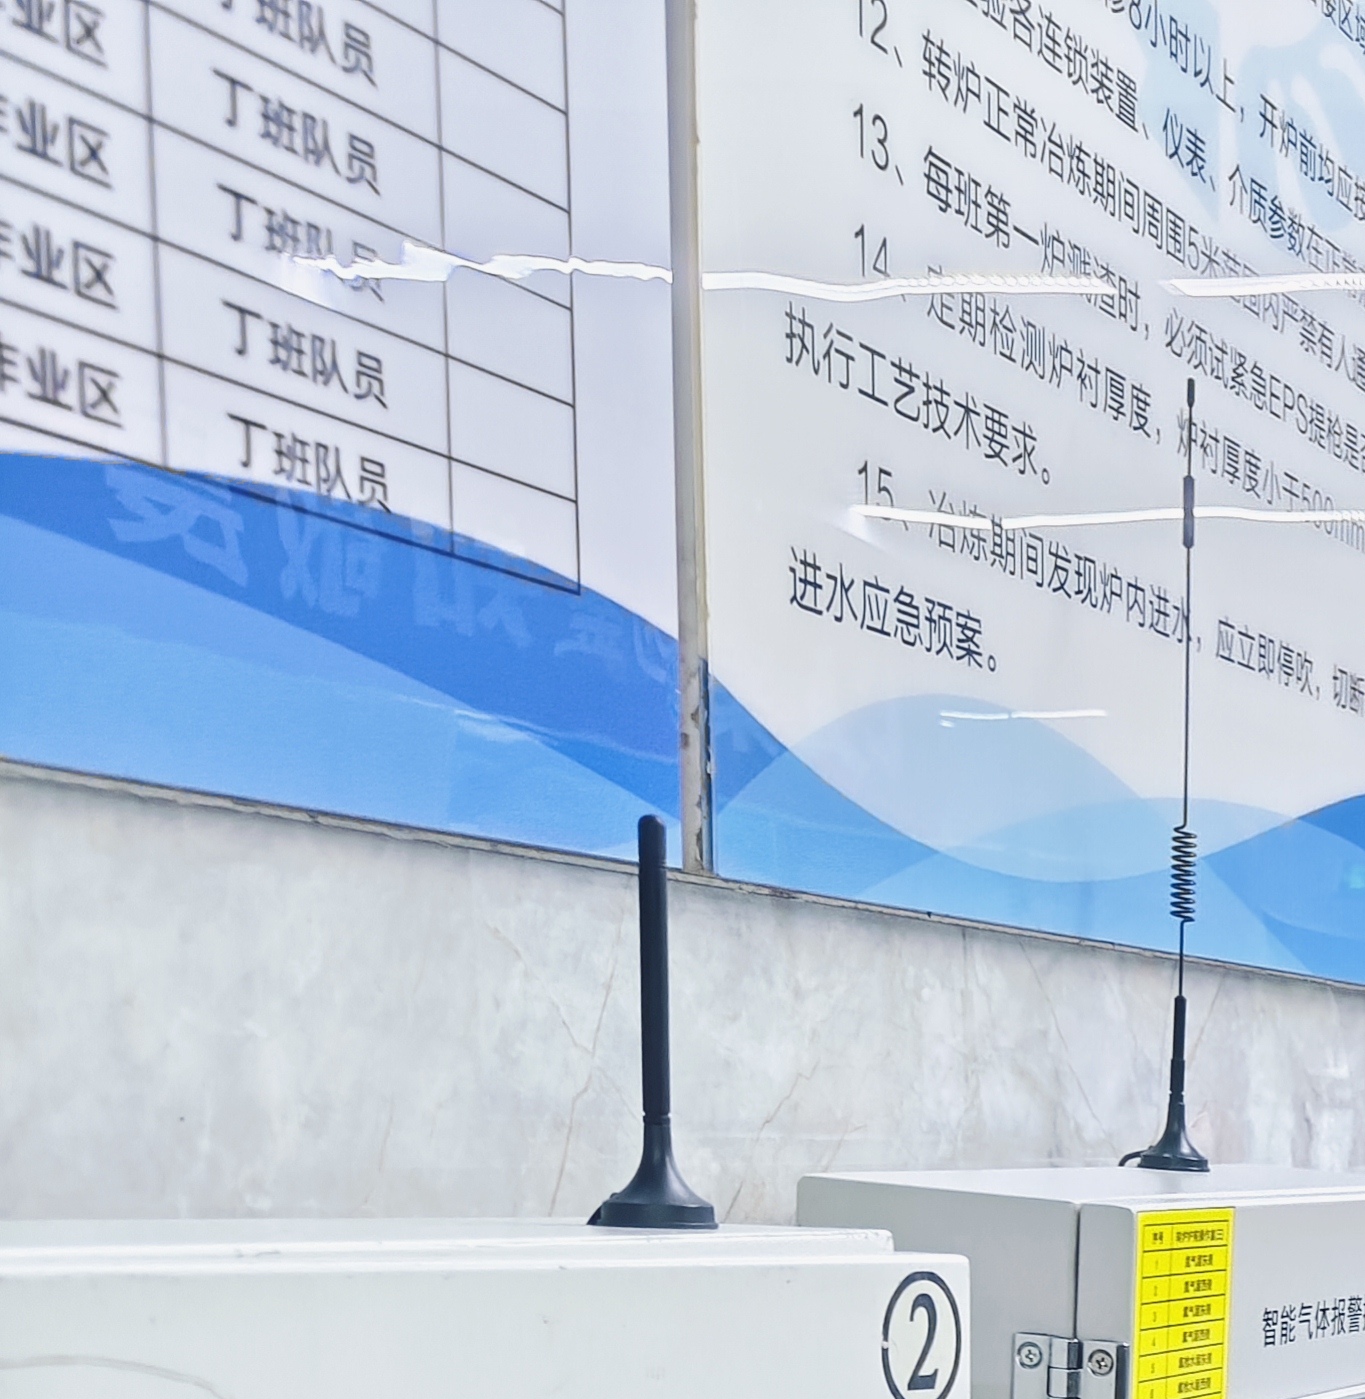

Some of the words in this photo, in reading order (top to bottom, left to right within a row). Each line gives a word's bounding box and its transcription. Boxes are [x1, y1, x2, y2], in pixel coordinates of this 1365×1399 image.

[221, 0, 378, 87] 班队员
[0, 95, 113, 190] 业区
[212, 68, 382, 196] 丁班队员
[0, 218, 117, 311] 业区
[0, 336, 125, 430] 业区
[222, 298, 389, 409] 丁班队员
[785, 309, 1052, 486] 执行工艺技术要求。
[227, 412, 392, 514] 丁班队员
[788, 546, 998, 673] 进水应急预案。
